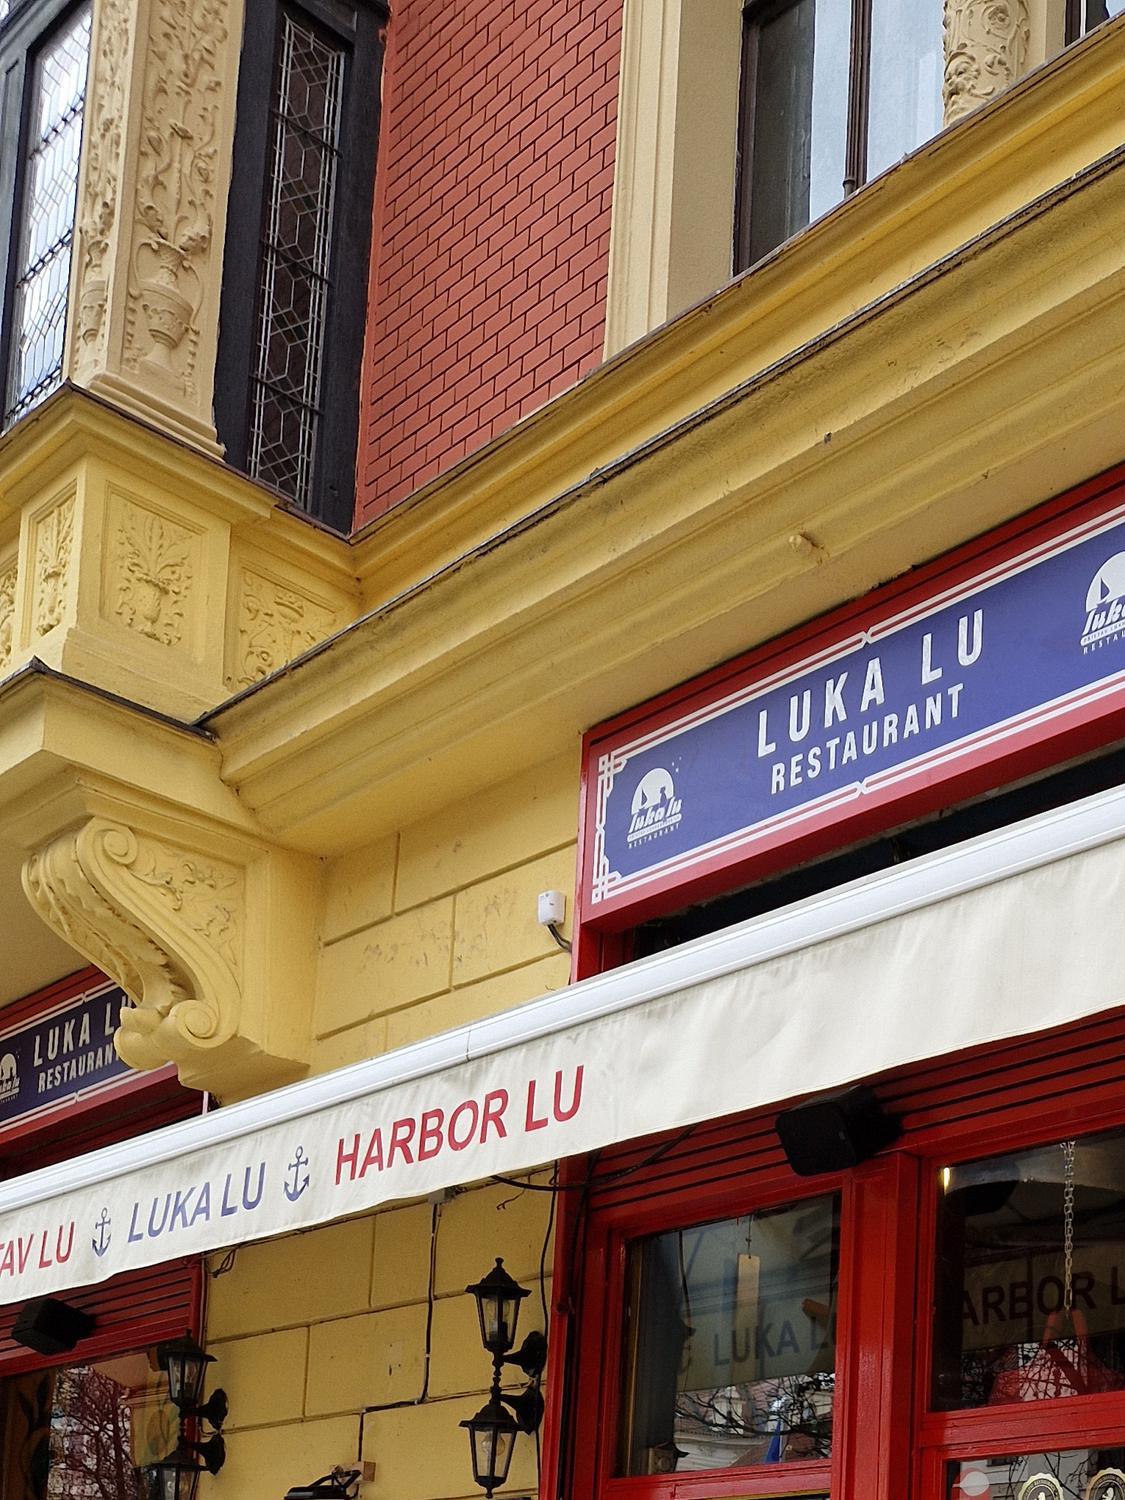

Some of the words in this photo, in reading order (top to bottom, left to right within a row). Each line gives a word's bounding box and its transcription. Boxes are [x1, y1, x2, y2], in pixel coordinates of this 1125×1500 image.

[756, 655, 886, 759] LUKA
[920, 608, 984, 686] LU
[769, 681, 965, 796] RESTAURANT
[34, 1011, 91, 1068] LUKA
[335, 1088, 509, 1186] HARBOR
[524, 1064, 585, 1133] LU
[127, 1181, 211, 1243] LUKA
[220, 1162, 267, 1217] LU
[38, 1221, 76, 1270] LU
[963, 1270, 1098, 1326] ARBOR
